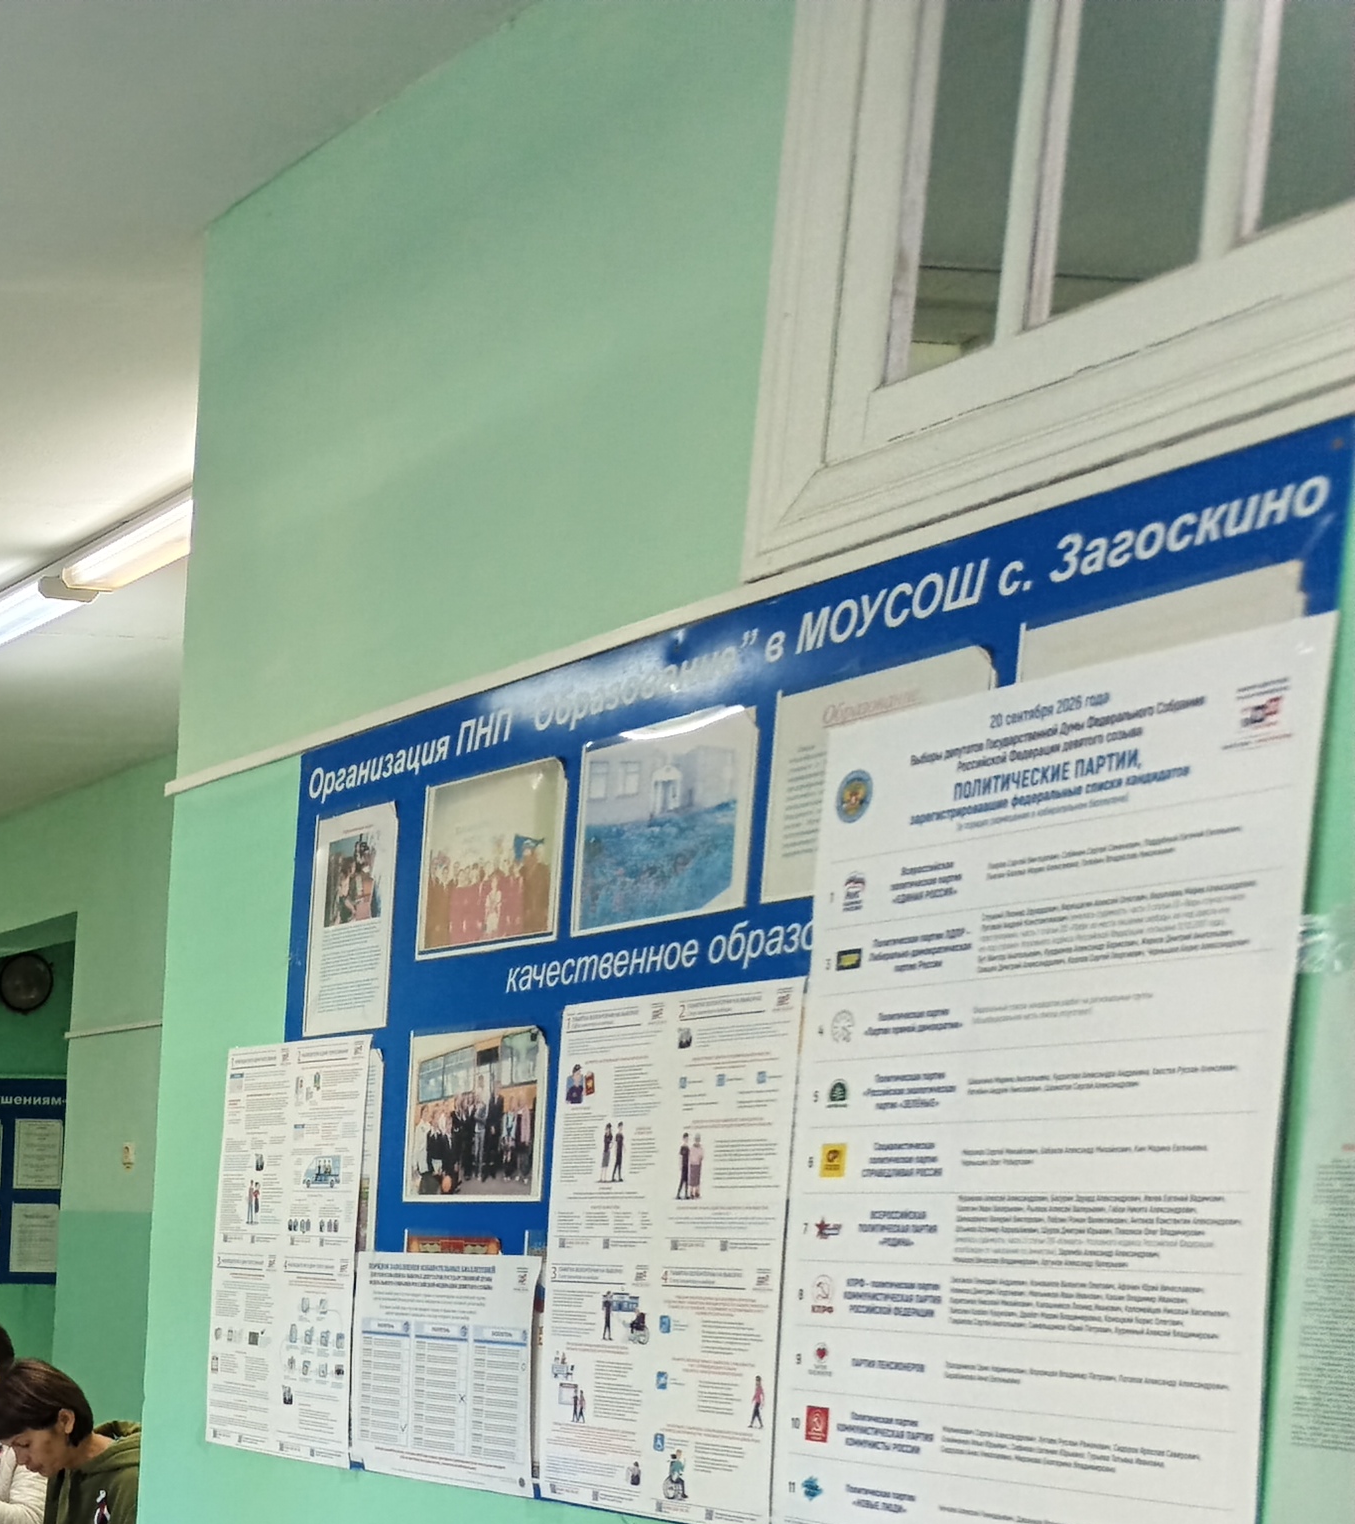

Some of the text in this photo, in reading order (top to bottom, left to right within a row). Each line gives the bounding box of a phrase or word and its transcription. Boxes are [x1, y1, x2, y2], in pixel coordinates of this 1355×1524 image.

[309, 475, 1330, 804] Организация ПНП Образование” в МОУСОШ с. Загоскино
[910, 750, 943, 767] Выборы
[986, 726, 1059, 752] Государственной
[1060, 720, 1085, 738] Думы
[1087, 705, 1155, 729] Федерального
[990, 714, 1003, 729] 20
[1005, 703, 1054, 727] сентября
[1085, 691, 1111, 709] года
[953, 748, 1142, 802] ПОЛИТИЧЕСКИЕ ПАРТИИ,
[1011, 785, 1082, 809] федеральные
[1125, 766, 1191, 787] кандидатов
[506, 939, 698, 993] качественное
[791, 1417, 801, 1430] 10
